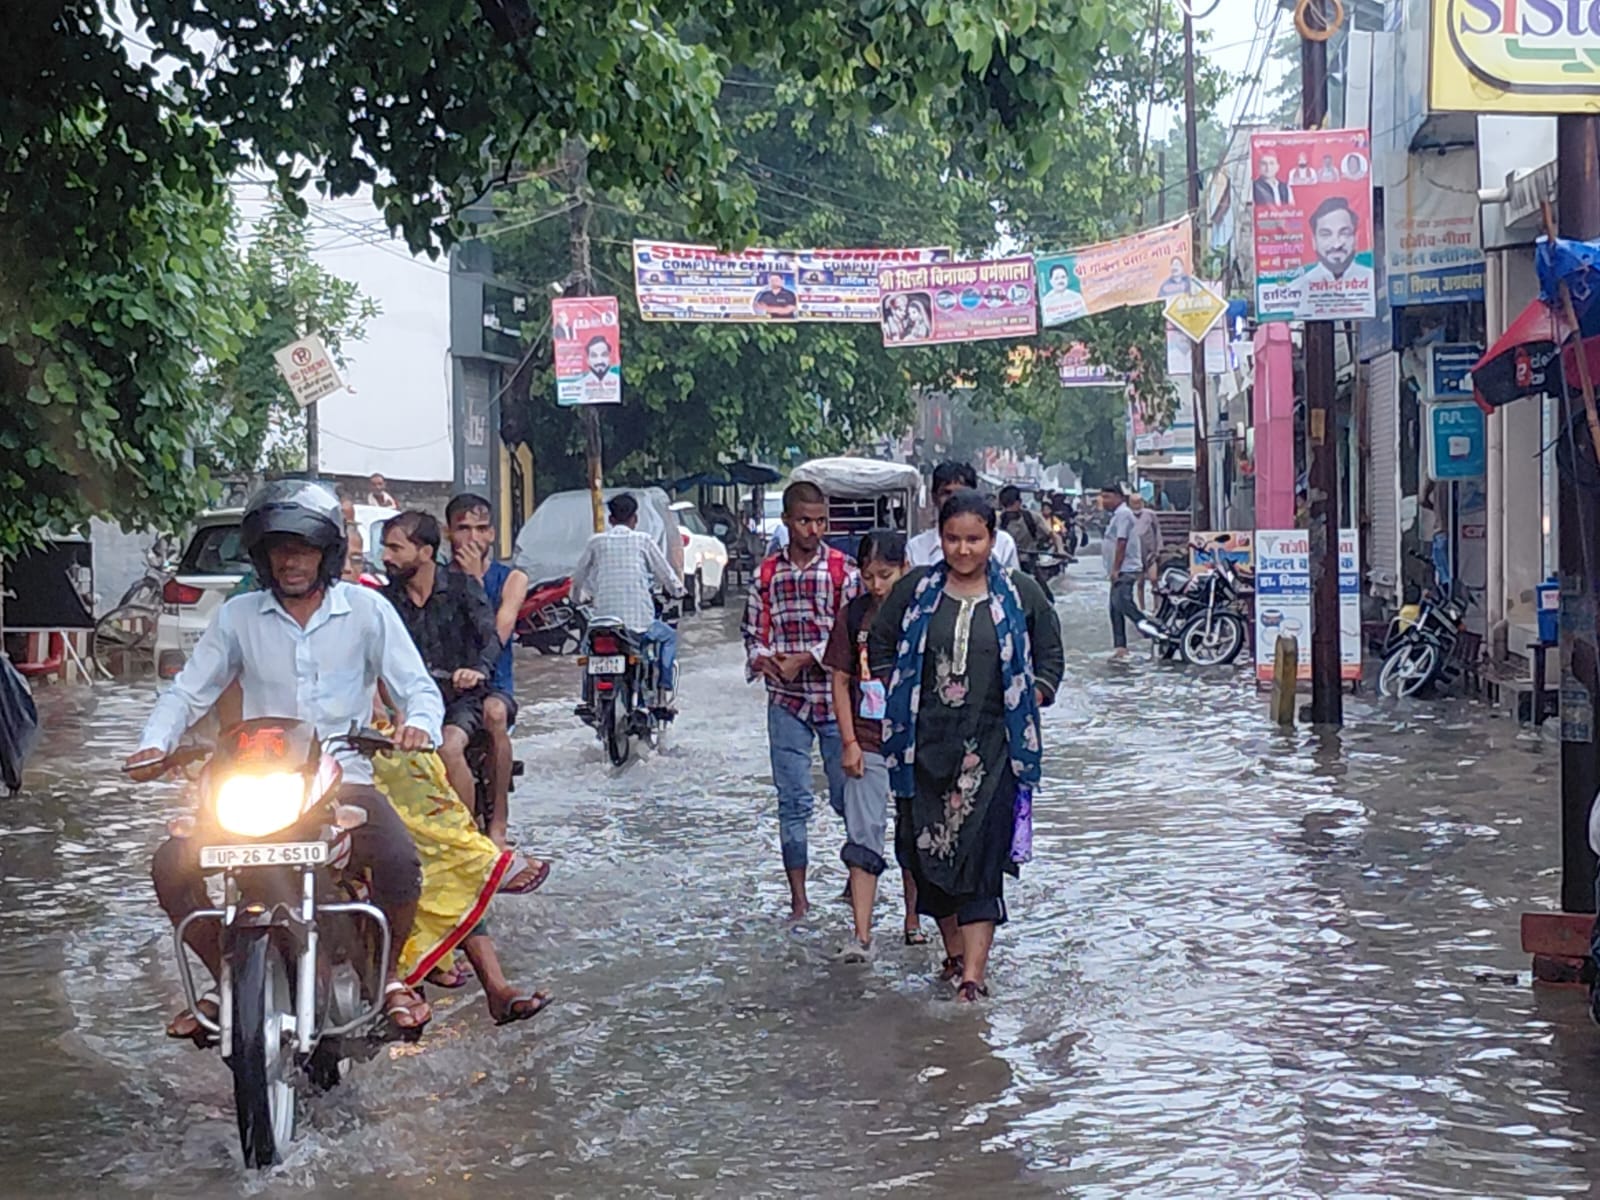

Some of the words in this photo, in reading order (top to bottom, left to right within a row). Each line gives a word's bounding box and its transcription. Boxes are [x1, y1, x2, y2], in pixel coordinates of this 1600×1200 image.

[217, 851, 237, 864] UP
[242, 849, 261, 864] 26
[267, 848, 277, 862] Z
[283, 846, 321, 862] 6510
